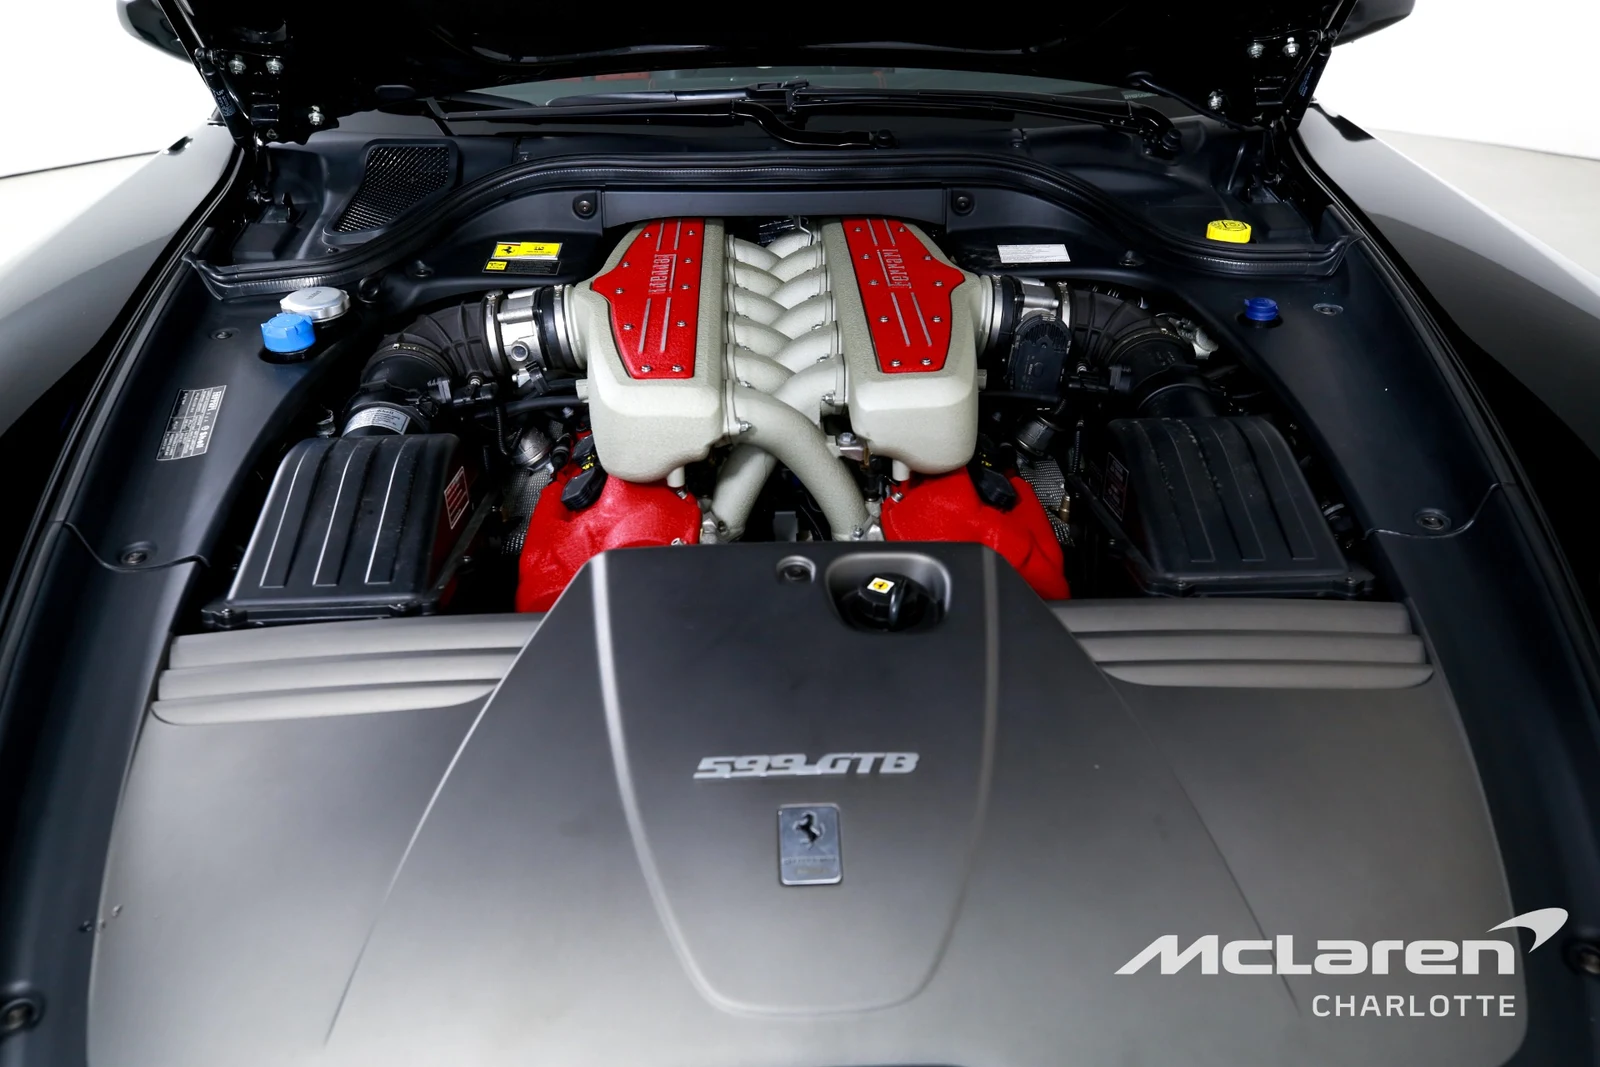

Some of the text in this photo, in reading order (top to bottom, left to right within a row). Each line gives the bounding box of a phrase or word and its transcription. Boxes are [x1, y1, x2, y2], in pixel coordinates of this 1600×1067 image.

[648, 253, 677, 294] Ferrari
[876, 248, 912, 289] Ferrari
[693, 752, 920, 780] 599 GTB
